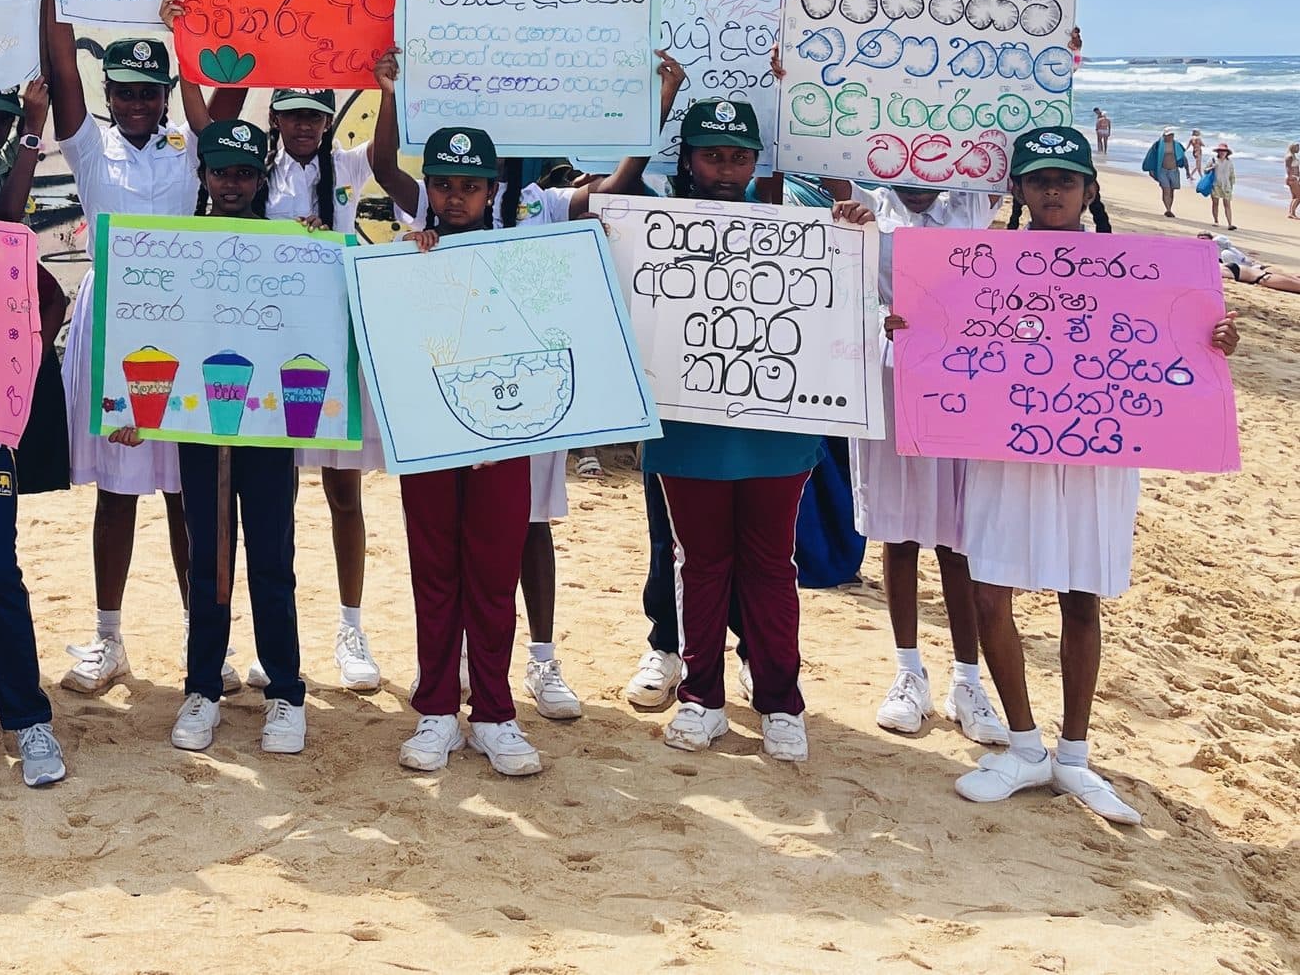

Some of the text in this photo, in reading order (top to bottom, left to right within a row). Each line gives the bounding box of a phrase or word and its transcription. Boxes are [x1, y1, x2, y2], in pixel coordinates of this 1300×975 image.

[789, 82, 881, 137] මුදා
[113, 231, 203, 259] පරිසරය
[949, 243, 1161, 280] අපි පරිසරය
[633, 262, 696, 309] අප
[1110, 312, 1158, 344] විට
[1073, 348, 1195, 386] පරිසර
